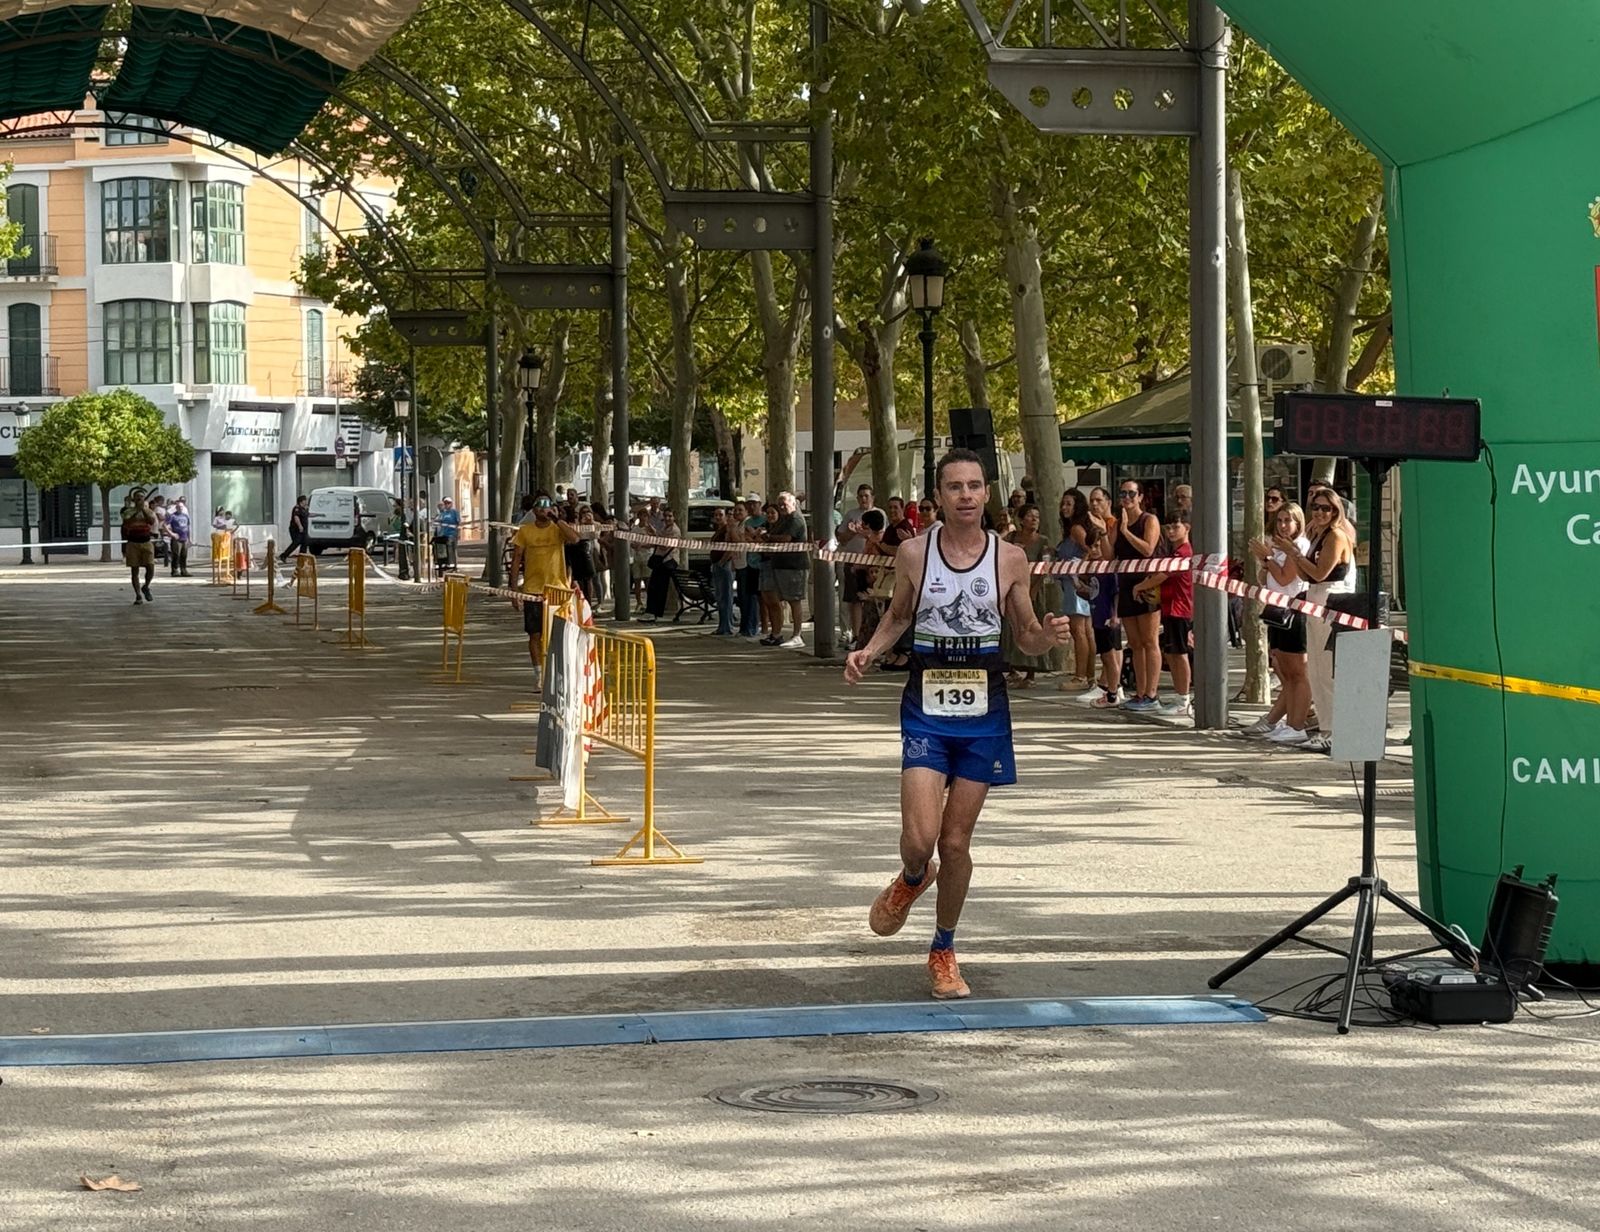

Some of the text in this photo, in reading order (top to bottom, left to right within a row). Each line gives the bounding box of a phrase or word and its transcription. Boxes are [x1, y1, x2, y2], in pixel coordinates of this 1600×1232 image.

[1511, 463, 1600, 503] Ayun
[934, 688, 976, 705] 139
[1512, 757, 1600, 783] CAMI
